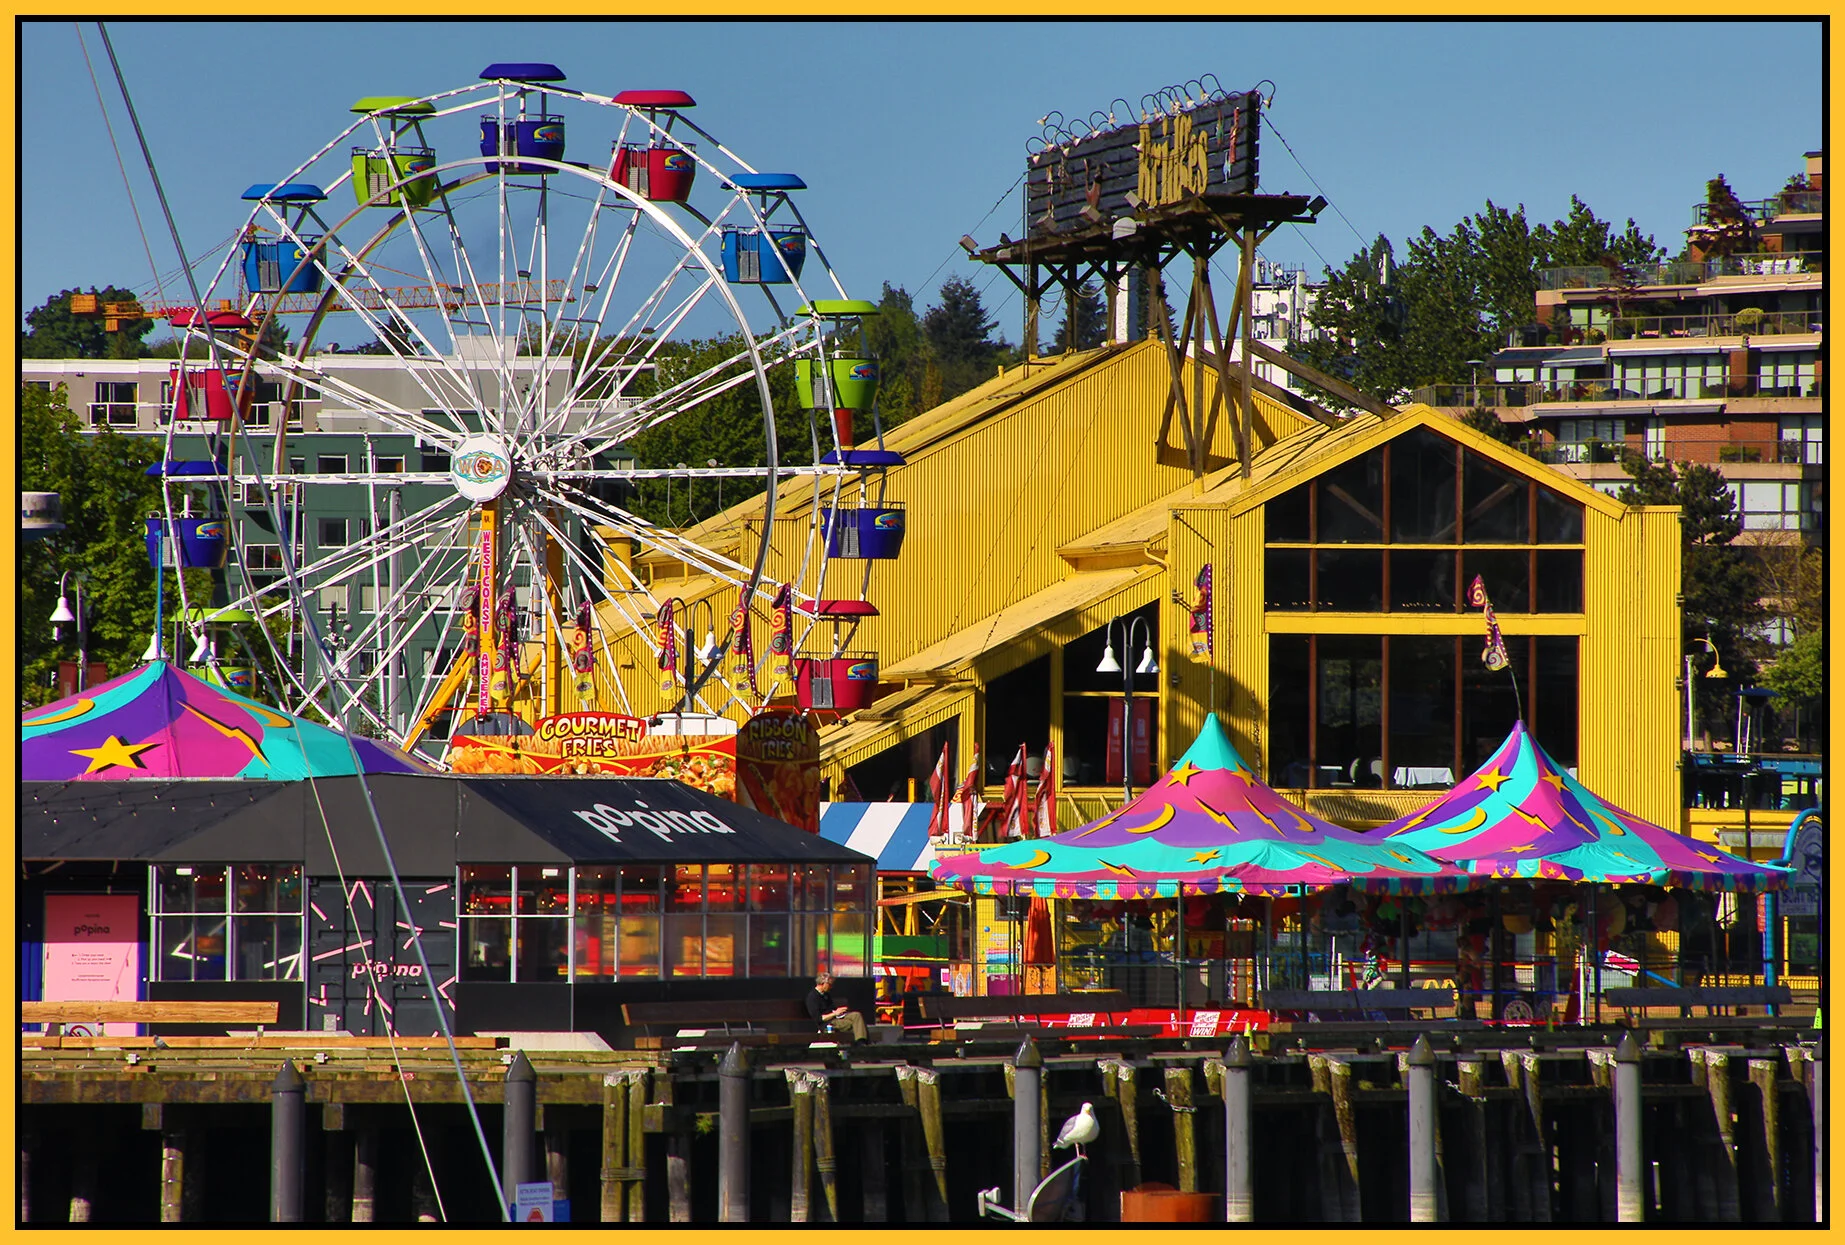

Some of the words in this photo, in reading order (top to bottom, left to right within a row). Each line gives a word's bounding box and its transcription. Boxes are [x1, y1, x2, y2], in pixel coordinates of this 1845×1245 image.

[481, 530, 492, 634] WESTCOAST
[540, 716, 640, 742] GOURMET
[749, 718, 807, 745] RIBBON
[561, 738, 617, 758] FRIES
[761, 740, 794, 760] FRIES
[572, 800, 737, 843] popina
[74, 924, 110, 936] popina
